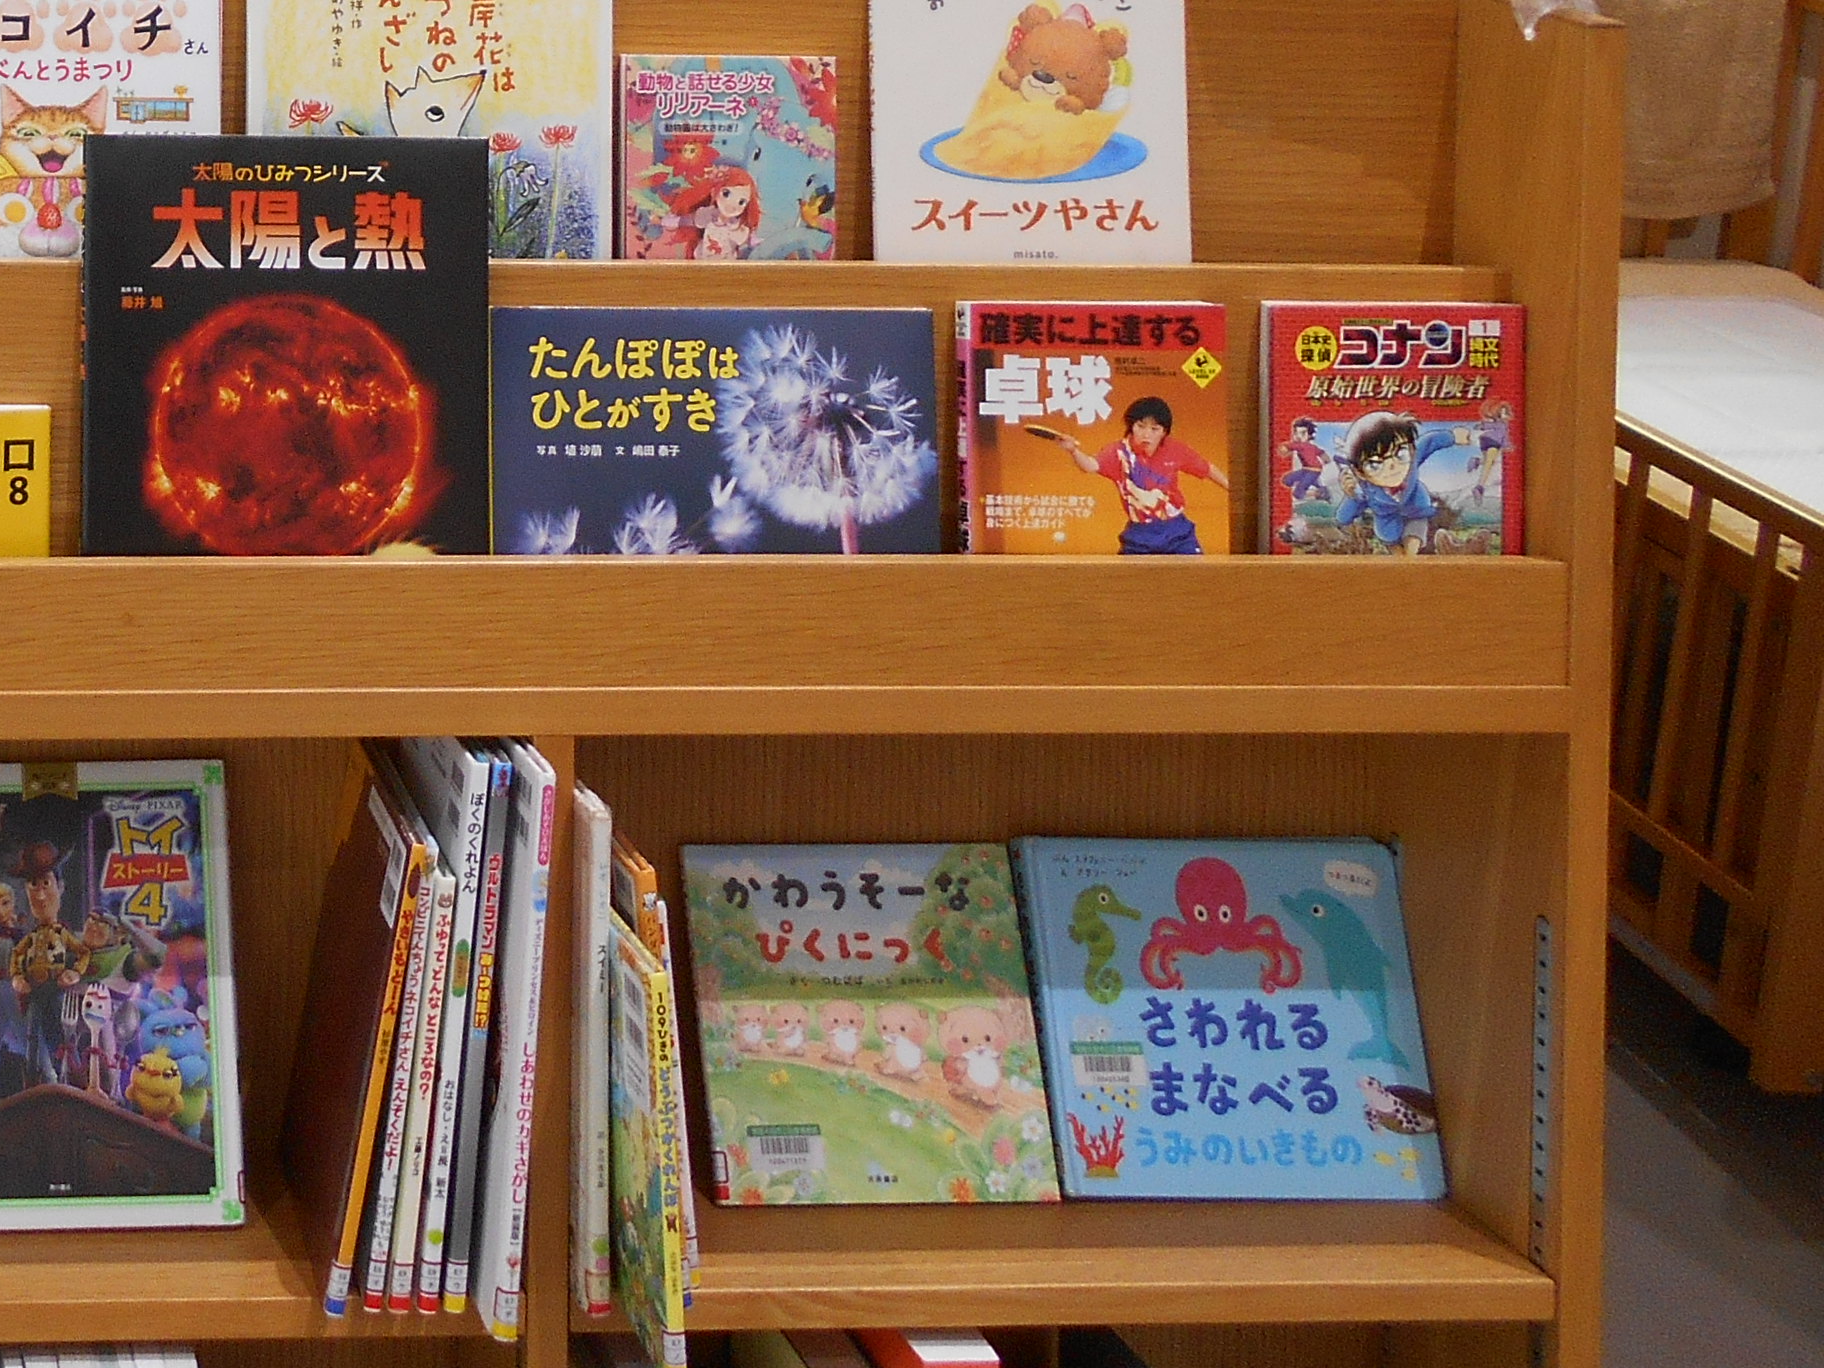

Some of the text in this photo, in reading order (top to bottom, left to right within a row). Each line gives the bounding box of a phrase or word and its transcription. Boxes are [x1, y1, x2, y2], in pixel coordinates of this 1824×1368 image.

[184, 39, 209, 55] さん
[637, 73, 773, 92] 動物と話せる少女
[658, 93, 746, 117] リリアーネ
[192, 162, 385, 182] 太陽のひみつシリーズ
[151, 188, 426, 269] 太陽と熱
[911, 197, 1159, 232] スイーツやさん
[980, 313, 1201, 346] 確実に上達する
[1302, 336, 1331, 346] 日本史
[1334, 320, 1466, 368] コナン
[528, 336, 740, 380] たんぽぽは
[1301, 350, 1331, 363] 探偵
[979, 354, 1113, 425] 卓球
[1306, 376, 1489, 399] 原始世界の冒険者
[530, 388, 717, 432] ひとがすき
[8, 476, 29, 505] 8
[147, 799, 183, 811] PIXAR
[117, 816, 184, 857] トイ
[462, 793, 485, 894] ぼくのくれよん
[112, 861, 184, 880] ストーリー
[723, 870, 969, 911] かわうそーな
[126, 883, 169, 926] 4
[482, 853, 503, 949] ウルトラマン
[755, 920, 953, 973] ぴくにっく
[1139, 996, 1329, 1051] さわれる
[1149, 1062, 1339, 1117] まなべる
[512, 1042, 536, 1205] しあわせのカギさがし
[1135, 1127, 1363, 1168] うみのいきもの
